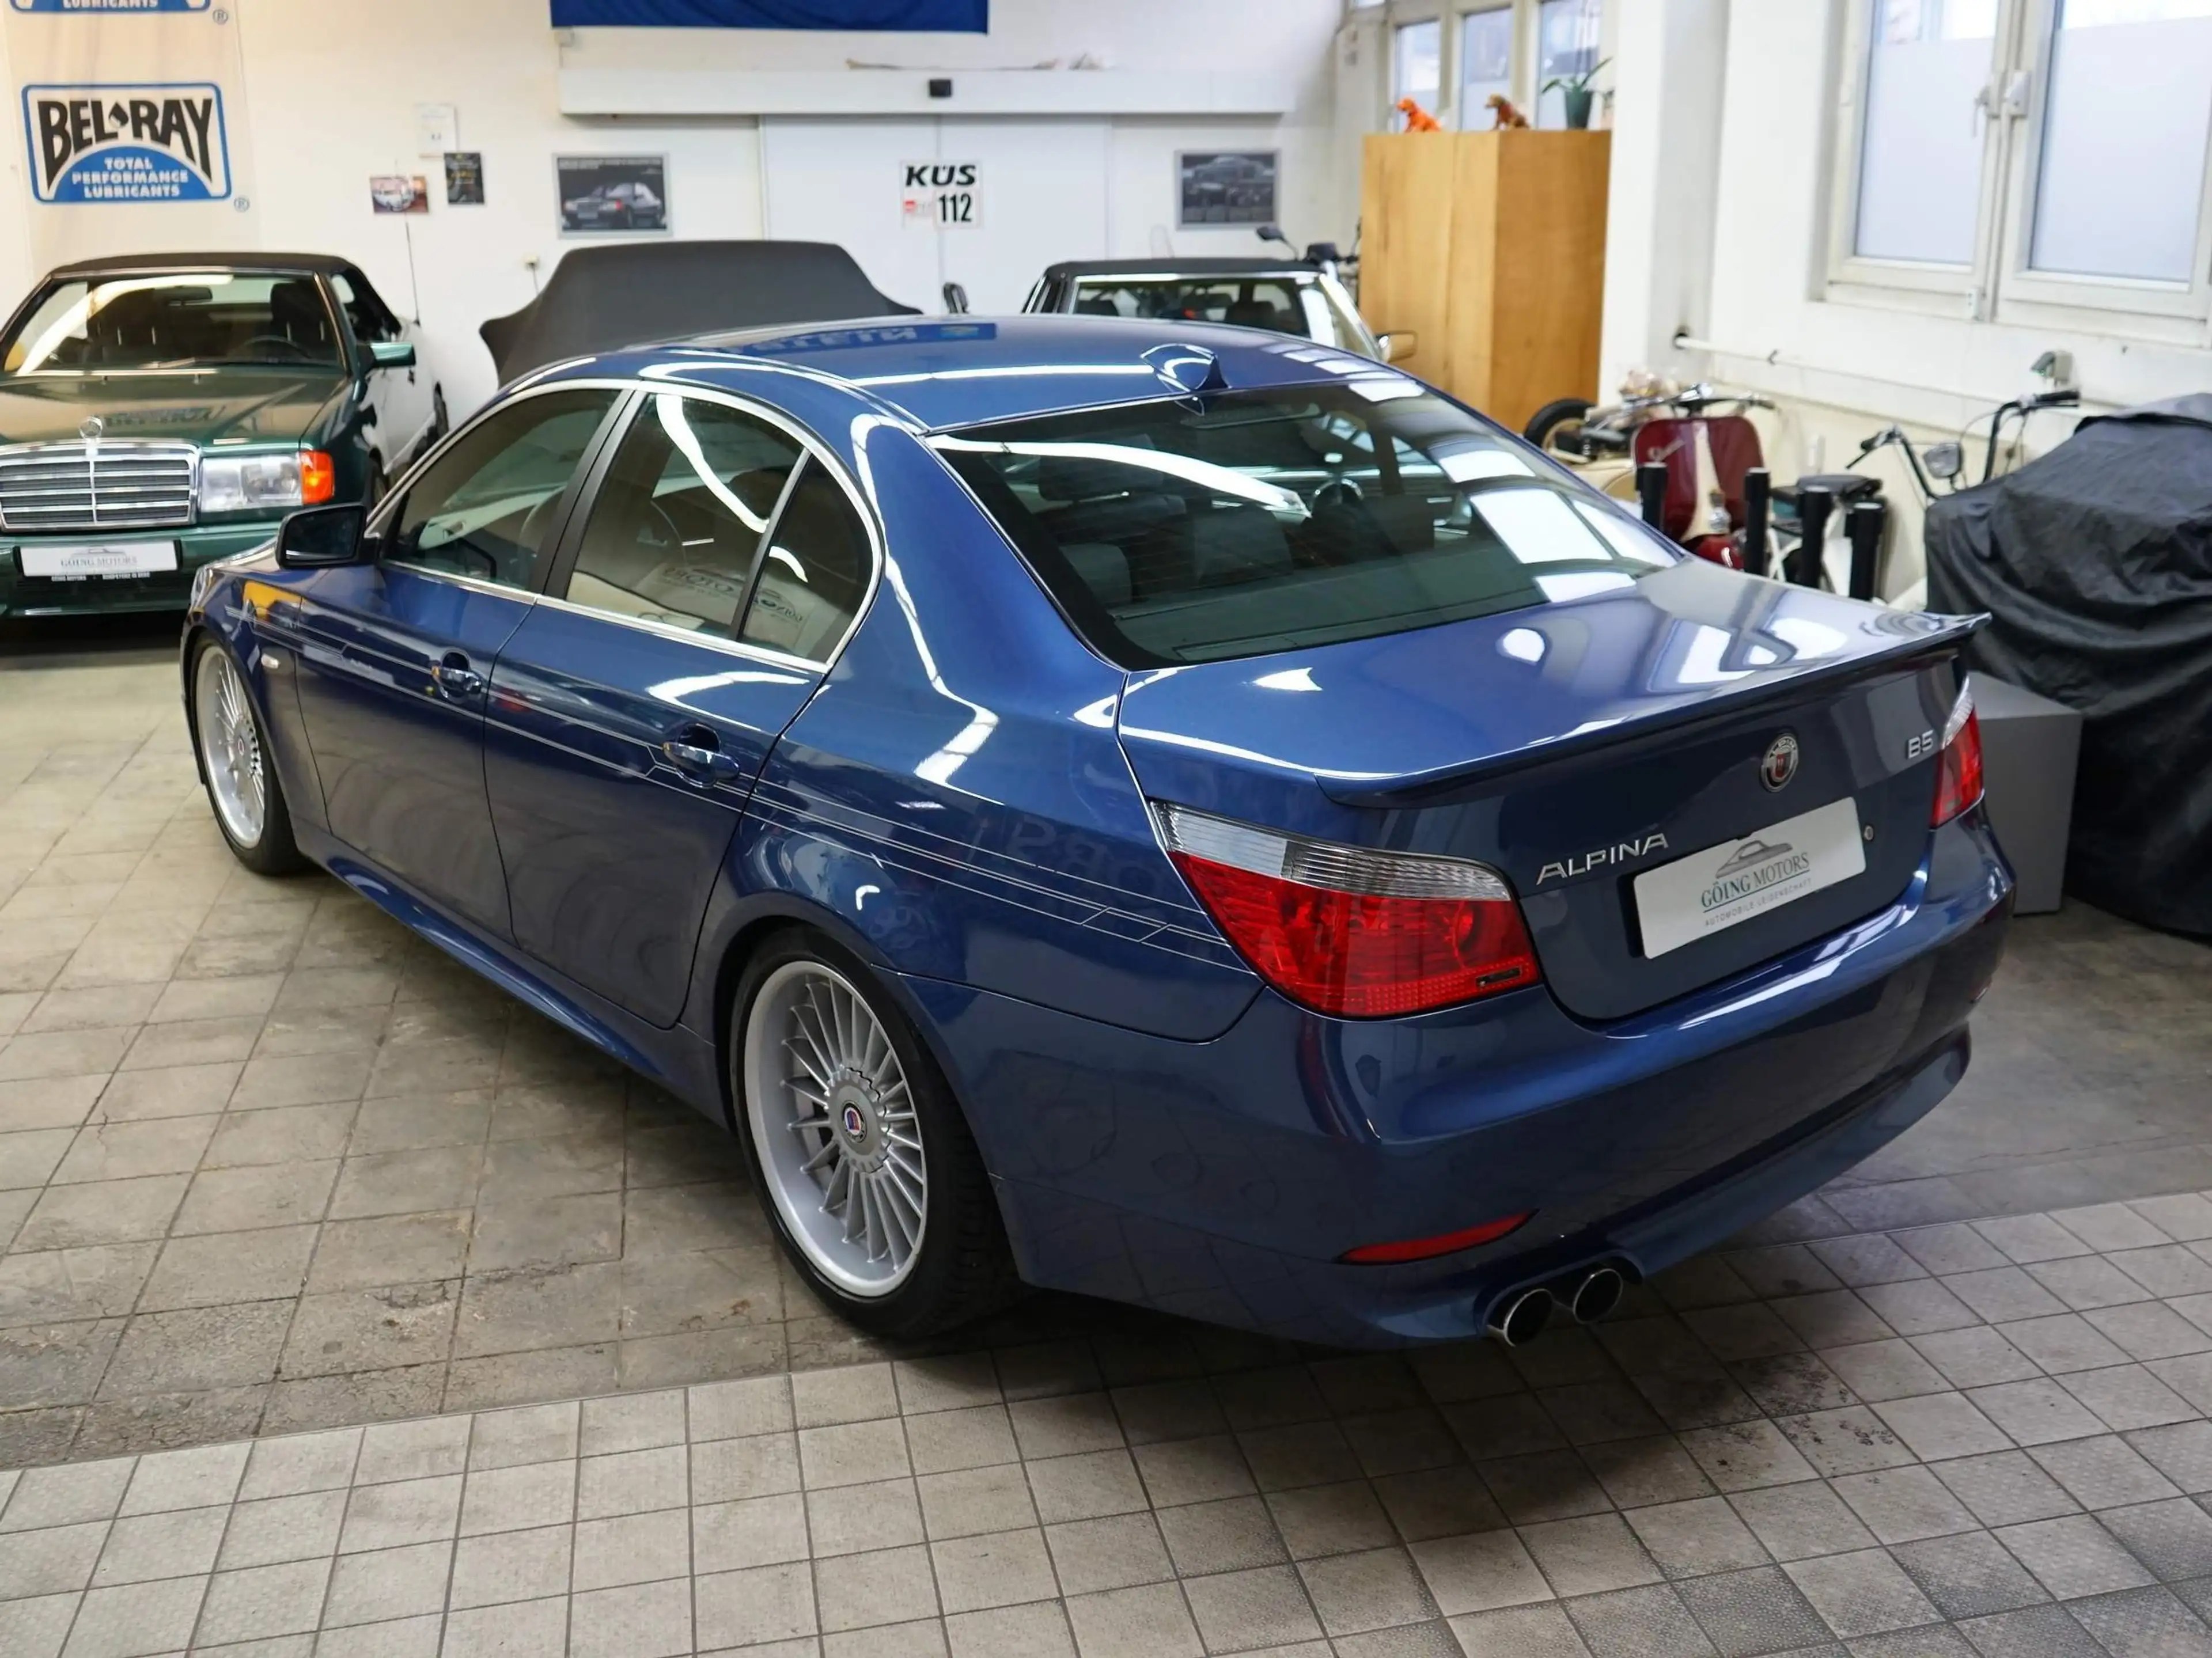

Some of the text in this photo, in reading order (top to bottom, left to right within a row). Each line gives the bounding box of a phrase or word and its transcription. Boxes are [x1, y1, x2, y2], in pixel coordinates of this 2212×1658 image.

[72, 169, 189, 185] PERFORMANCE
[104, 157, 153, 170] TOTAL
[84, 184, 180, 198] LUBRICANTS
[939, 193, 972, 222] 112
[1908, 729, 1934, 759] B5
[1536, 833, 1669, 886] ALPINA
[1753, 852, 1810, 887] MOTORS
